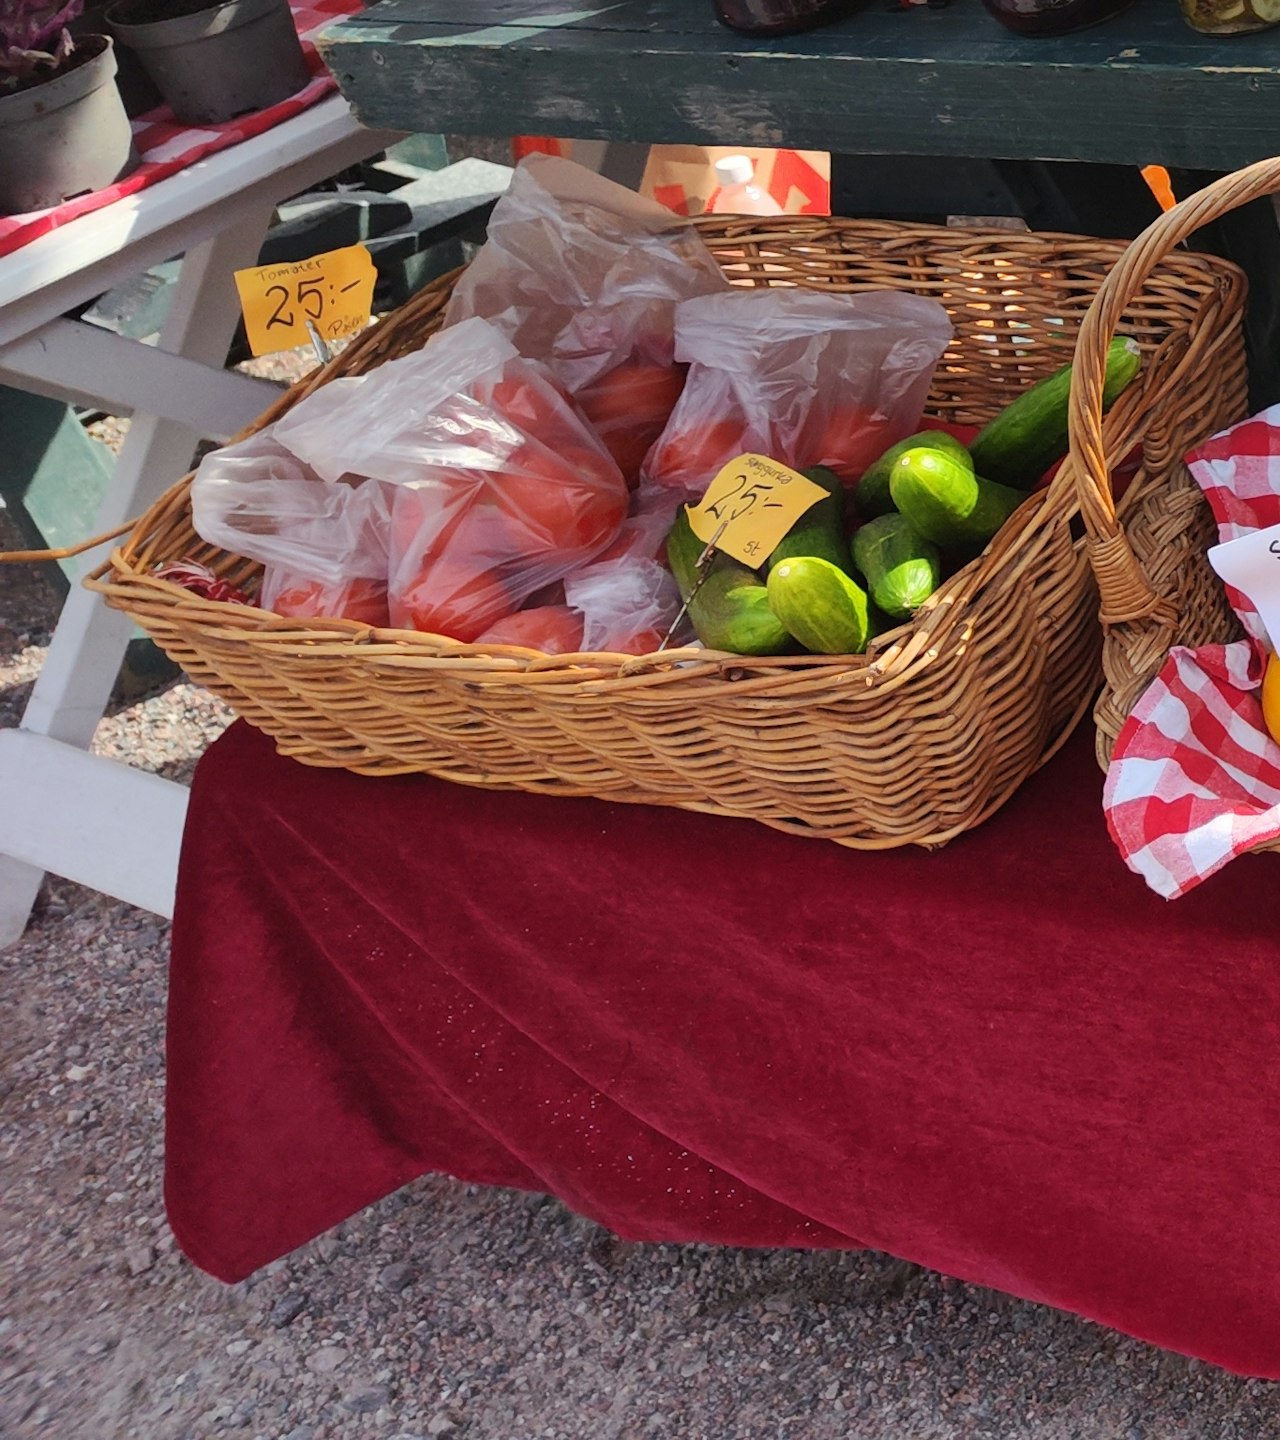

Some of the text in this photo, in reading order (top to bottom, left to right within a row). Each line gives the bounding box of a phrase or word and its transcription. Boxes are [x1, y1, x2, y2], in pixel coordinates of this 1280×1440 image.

[255, 257, 327, 282] Tomater
[264, 275, 362, 331] 25:-
[703, 473, 784, 522] 25:-
[742, 540, 762, 557] st
